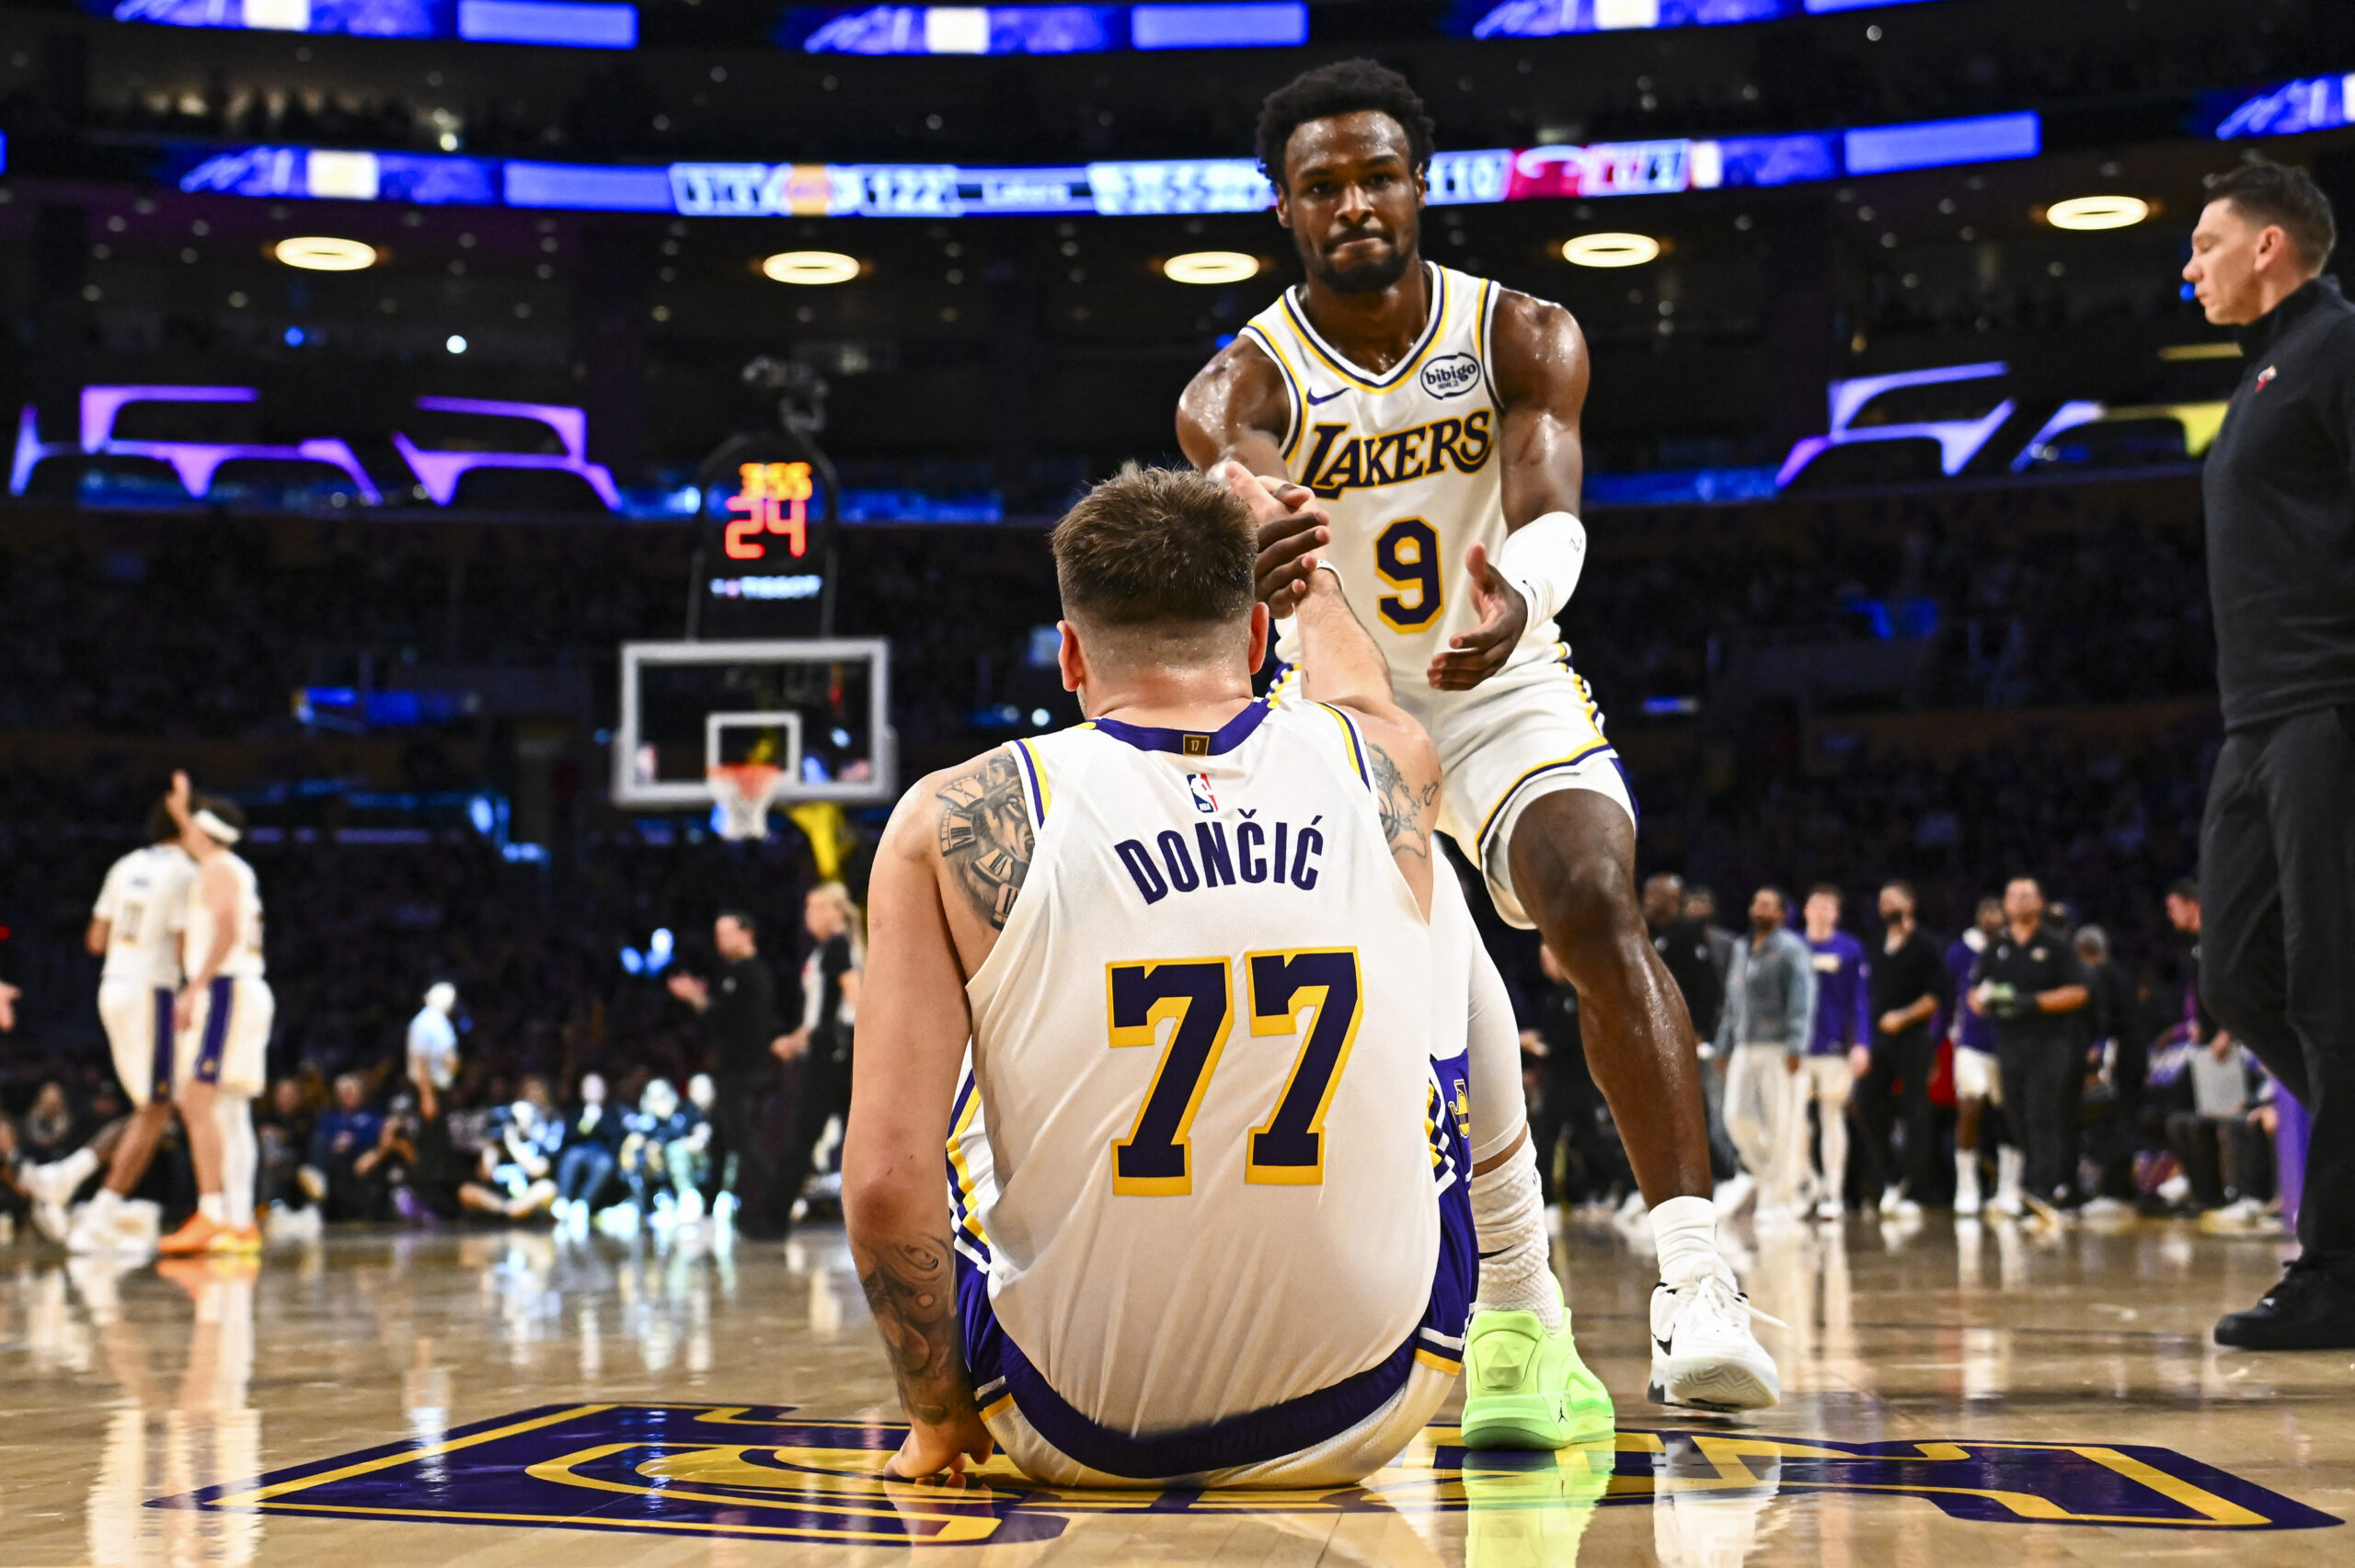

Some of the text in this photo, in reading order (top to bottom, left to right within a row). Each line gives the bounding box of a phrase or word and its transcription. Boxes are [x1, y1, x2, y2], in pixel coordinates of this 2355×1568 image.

[1425, 363, 1476, 384] bibigo
[1298, 407, 1493, 500] LAKERS
[725, 496, 806, 559] 24
[1374, 516, 1444, 635] 9
[1190, 739, 1200, 751] 17
[1114, 807, 1324, 905] DONČIĆ
[1106, 945, 1363, 1196] 77
